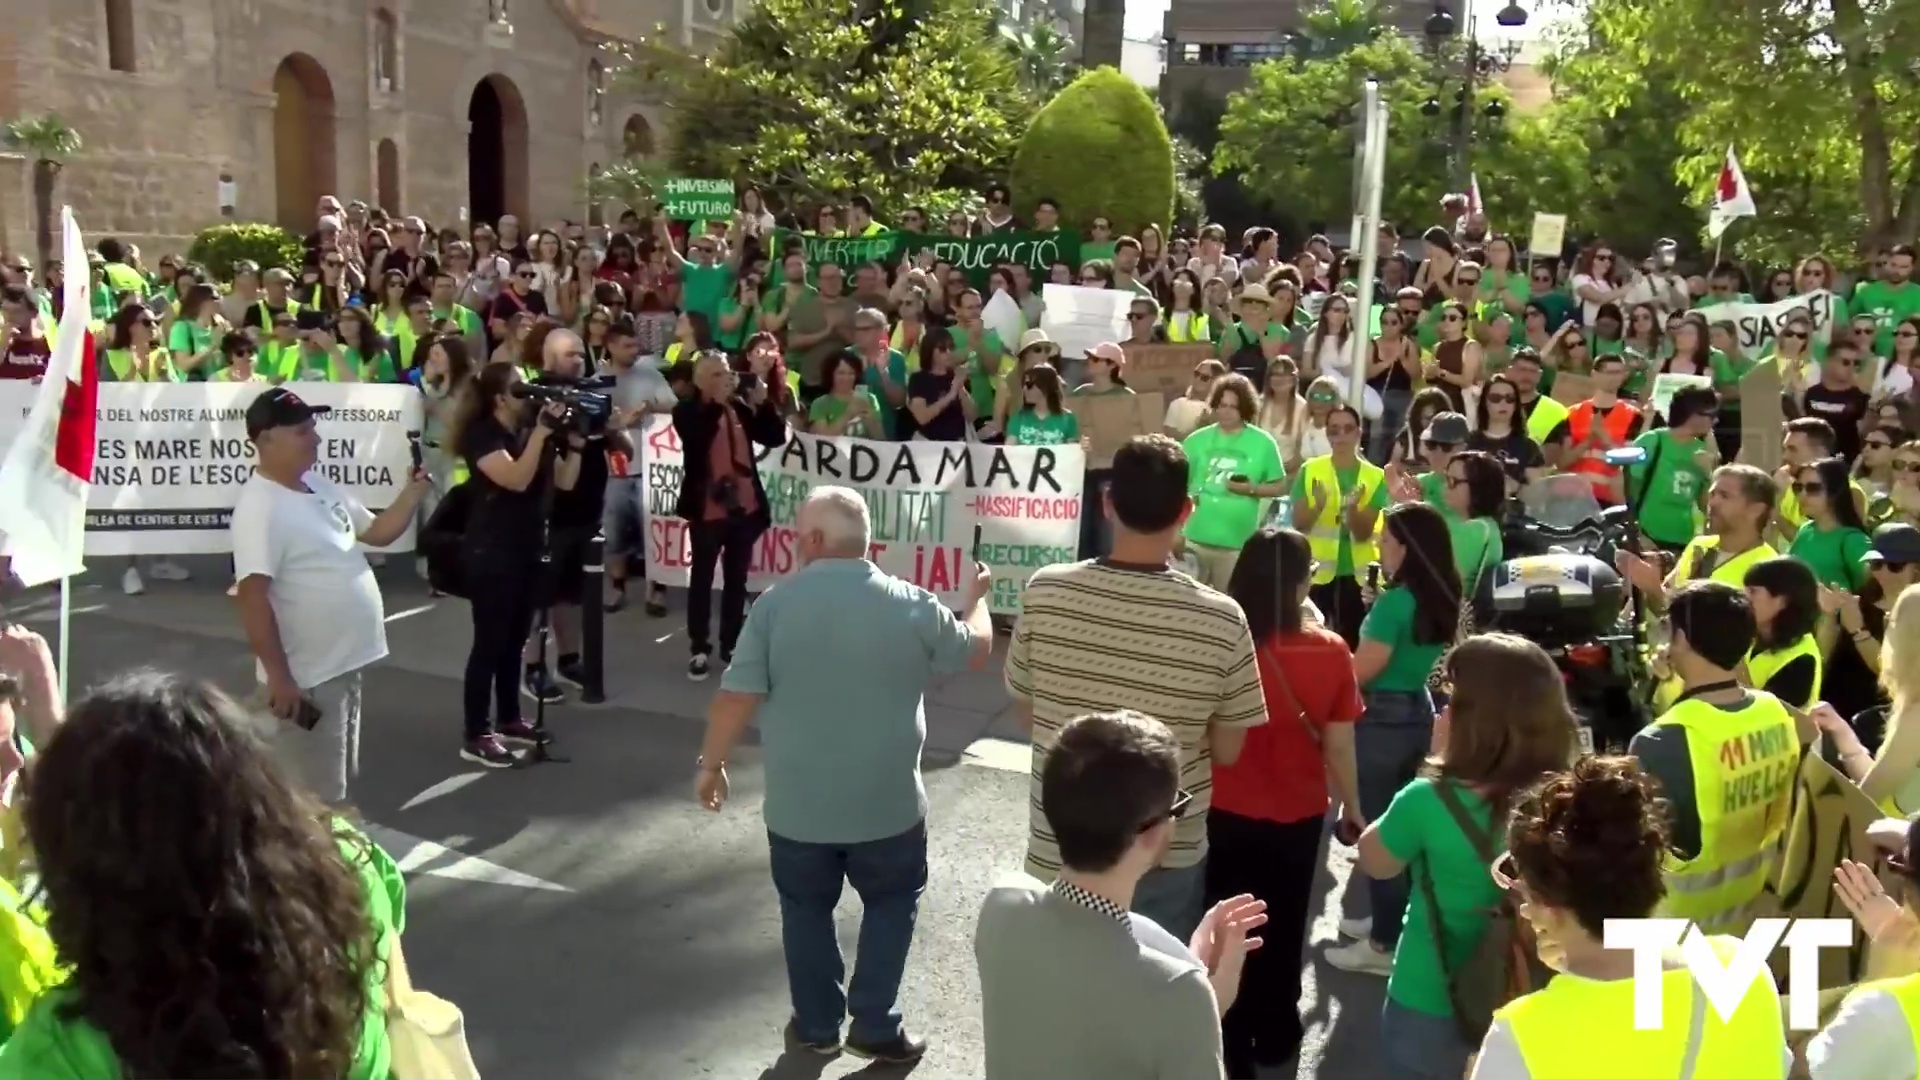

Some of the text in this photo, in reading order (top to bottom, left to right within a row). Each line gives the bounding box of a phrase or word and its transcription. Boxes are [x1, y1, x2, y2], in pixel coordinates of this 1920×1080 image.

[664, 200, 732, 215] +FUTURO
[107, 408, 133, 422] DEL
[140, 408, 195, 422] NOSTRE
[199, 408, 247, 422] ALUMN
[314, 408, 401, 423] ROFESSORAT
[135, 439, 202, 460] MARE
[327, 438, 356, 459] EN
[754, 431, 1062, 493] ARDAMAR
[151, 466, 181, 485] DE
[135, 513, 176, 526] CENTRE
[862, 488, 952, 543] ALITAT
